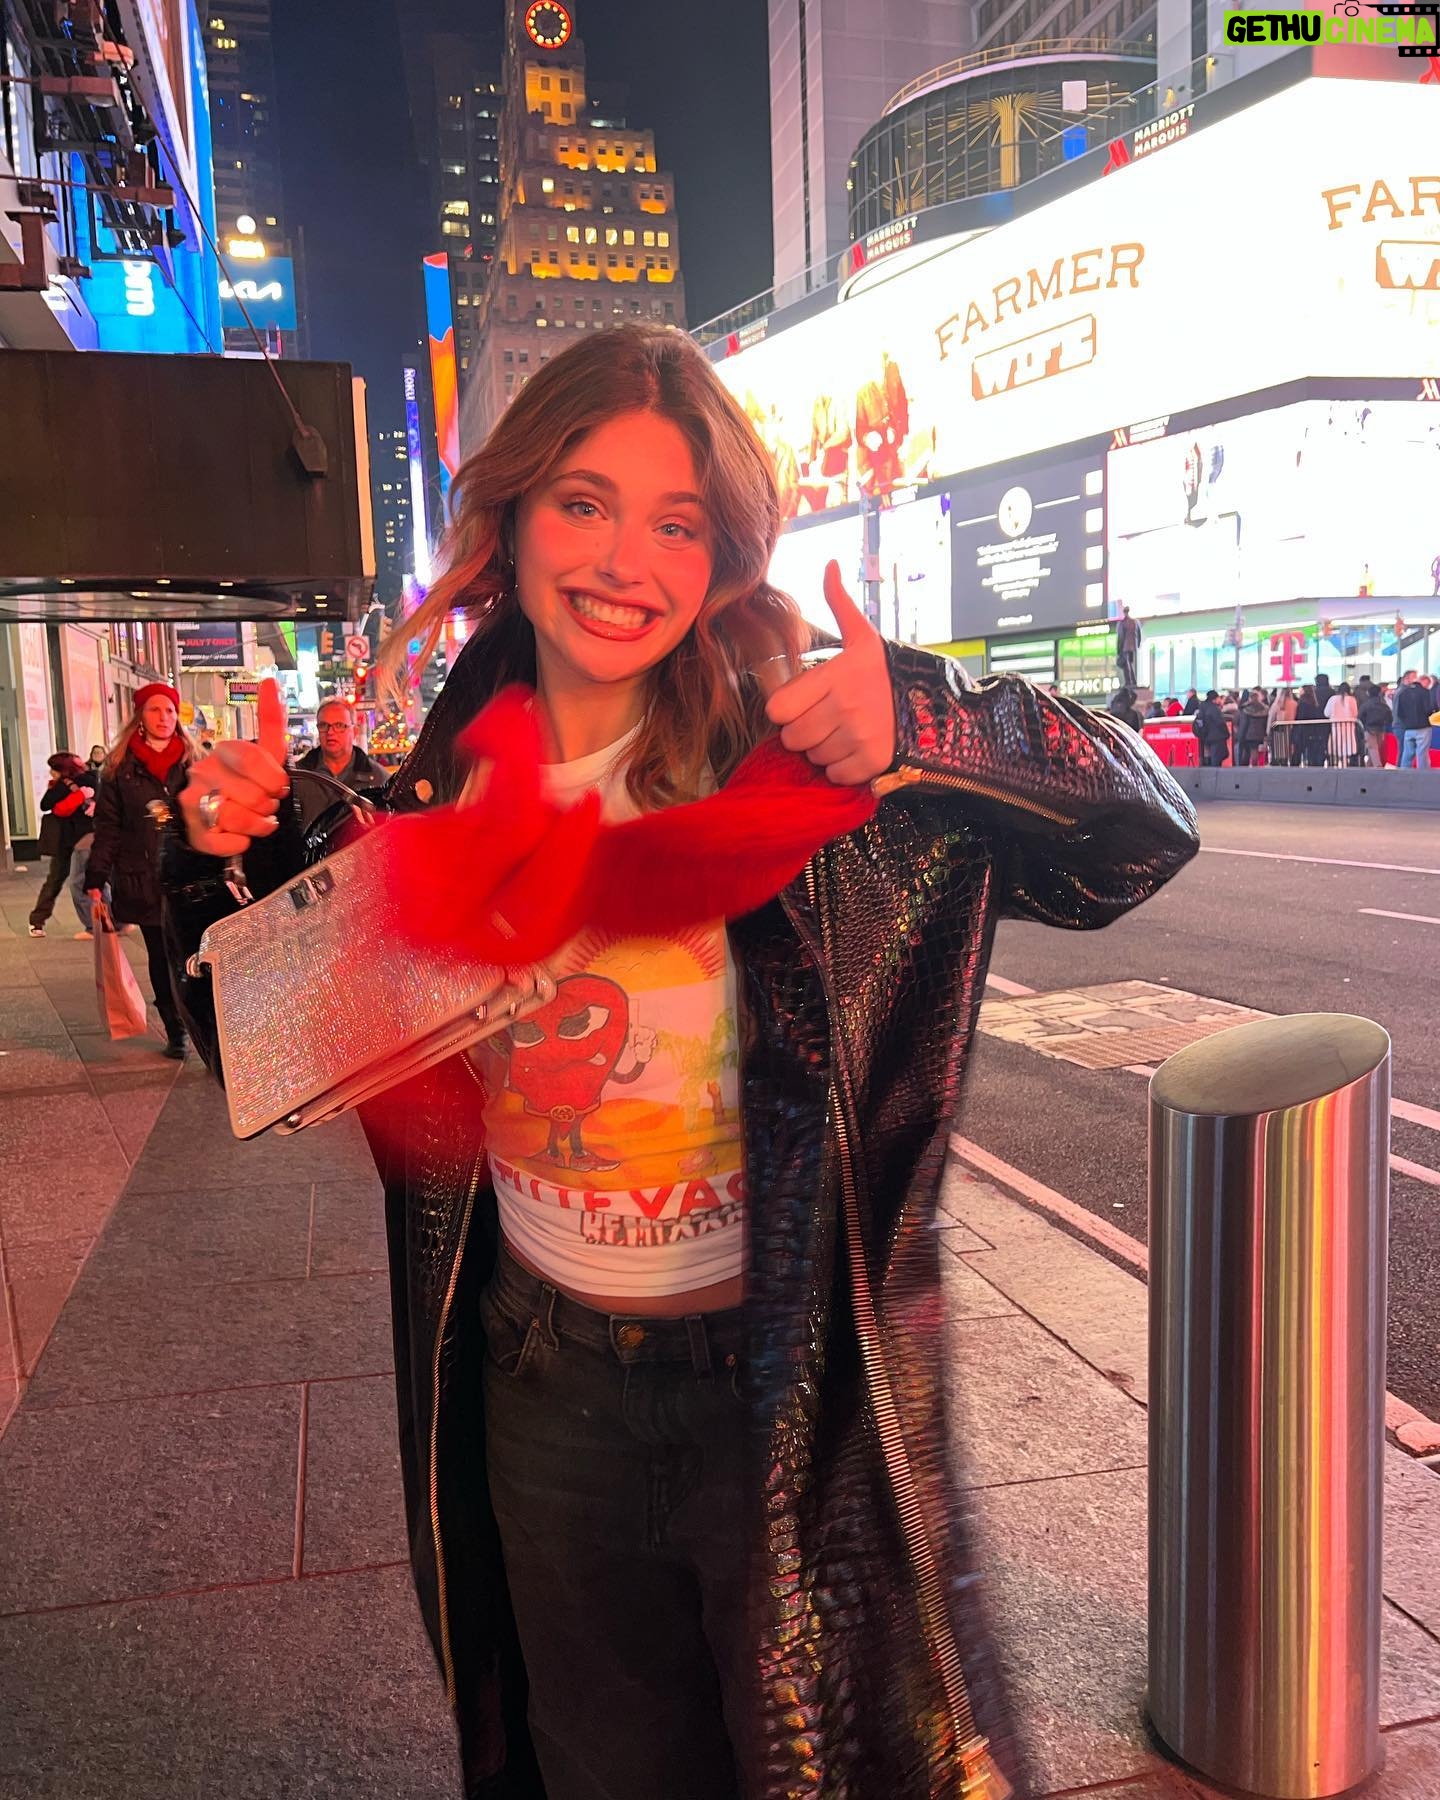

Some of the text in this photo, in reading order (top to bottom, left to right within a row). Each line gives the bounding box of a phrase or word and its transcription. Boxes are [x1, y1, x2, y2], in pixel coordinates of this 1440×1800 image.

[1133, 103, 1196, 143] MARRIOTT
[1133, 122, 1188, 158] MARQUIS
[866, 215, 918, 247] MARRIOTT
[866, 231, 913, 260] MARQUIS
[935, 241, 1146, 361] FARMER
